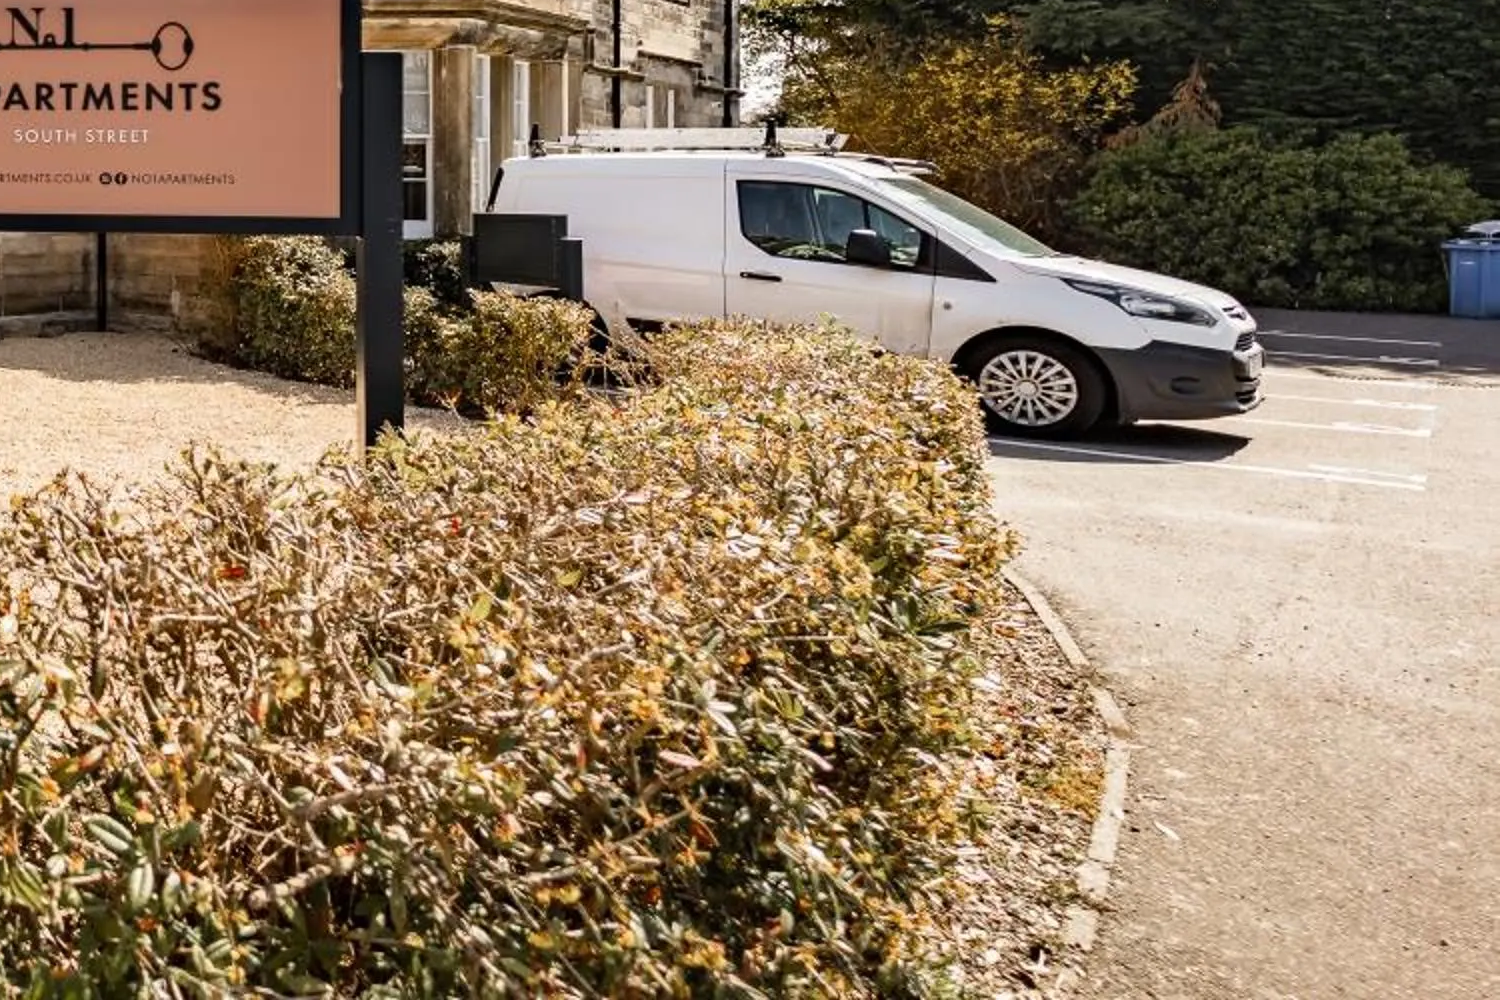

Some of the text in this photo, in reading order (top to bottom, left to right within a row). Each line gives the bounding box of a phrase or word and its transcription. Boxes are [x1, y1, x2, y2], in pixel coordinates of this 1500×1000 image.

[13, 129, 149, 143] SOUTH STREET
[131, 173, 236, 185] NO1APARTMENTS
